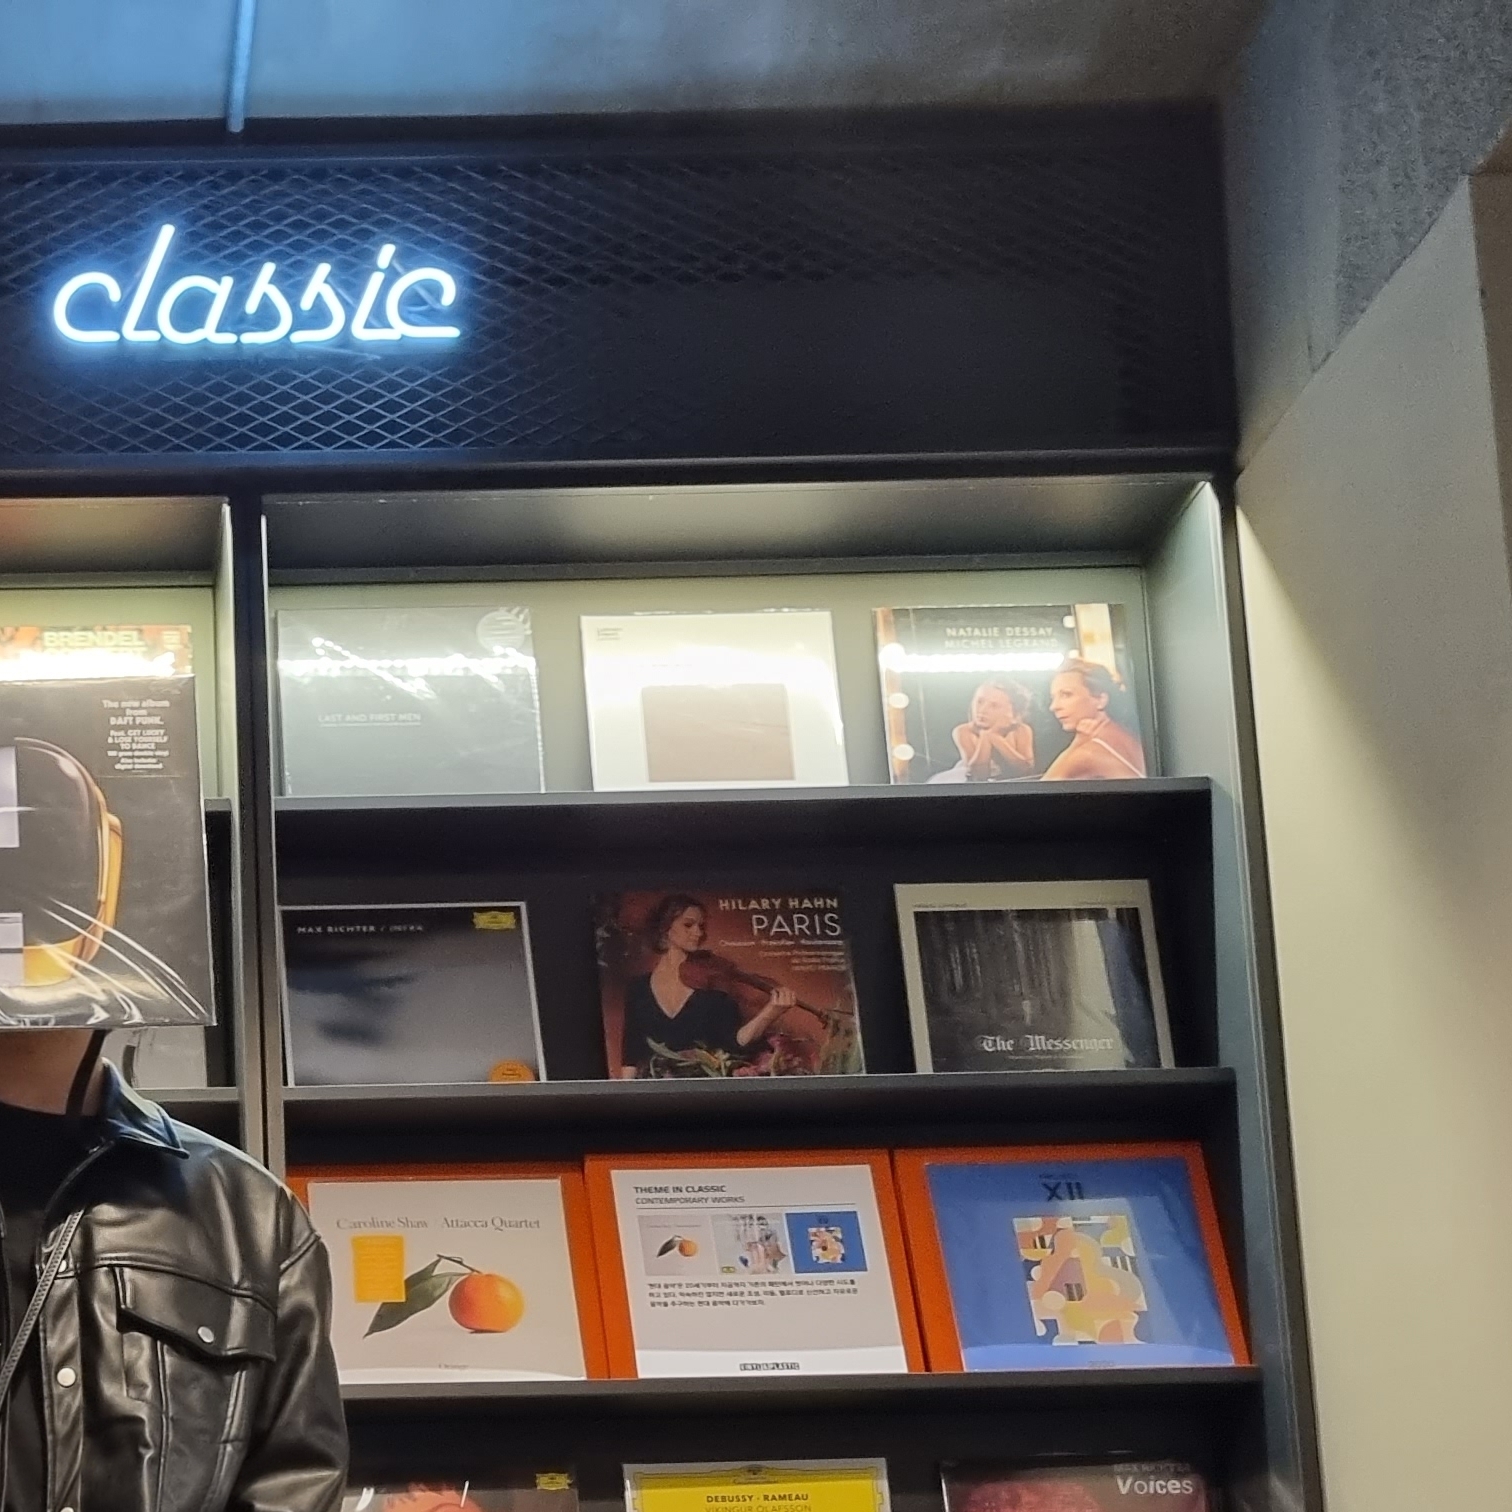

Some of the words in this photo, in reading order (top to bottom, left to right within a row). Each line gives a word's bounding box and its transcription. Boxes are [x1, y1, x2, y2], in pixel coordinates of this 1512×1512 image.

[53, 223, 461, 345] classic
[43, 630, 145, 646] BRENDEL
[945, 627, 1000, 637] NATALIE
[1005, 626, 1053, 637] DESSAY
[345, 714, 368, 722] AND
[369, 713, 397, 722] FIRST
[398, 713, 422, 721] MEN
[719, 898, 781, 911] HILARY
[788, 897, 838, 909] HAHN
[327, 925, 376, 933] RICHTER
[751, 912, 842, 937] PARIS
[981, 1035, 1015, 1052] The
[1025, 1034, 1114, 1052] Messenger
[633, 1186, 670, 1194] THEME
[685, 1185, 727, 1193] CLASSIC
[1041, 1181, 1085, 1201] XII
[635, 1197, 709, 1205] CONTEMPORARY
[336, 1216, 395, 1230] Caroline
[397, 1216, 428, 1229] Shaw
[441, 1216, 488, 1229] Attacca
[491, 1215, 541, 1232] Quartet
[1116, 1475, 1194, 1495] Voices
[706, 1494, 754, 1504] DEBUSSY
[763, 1493, 809, 1502] RAMEAU
